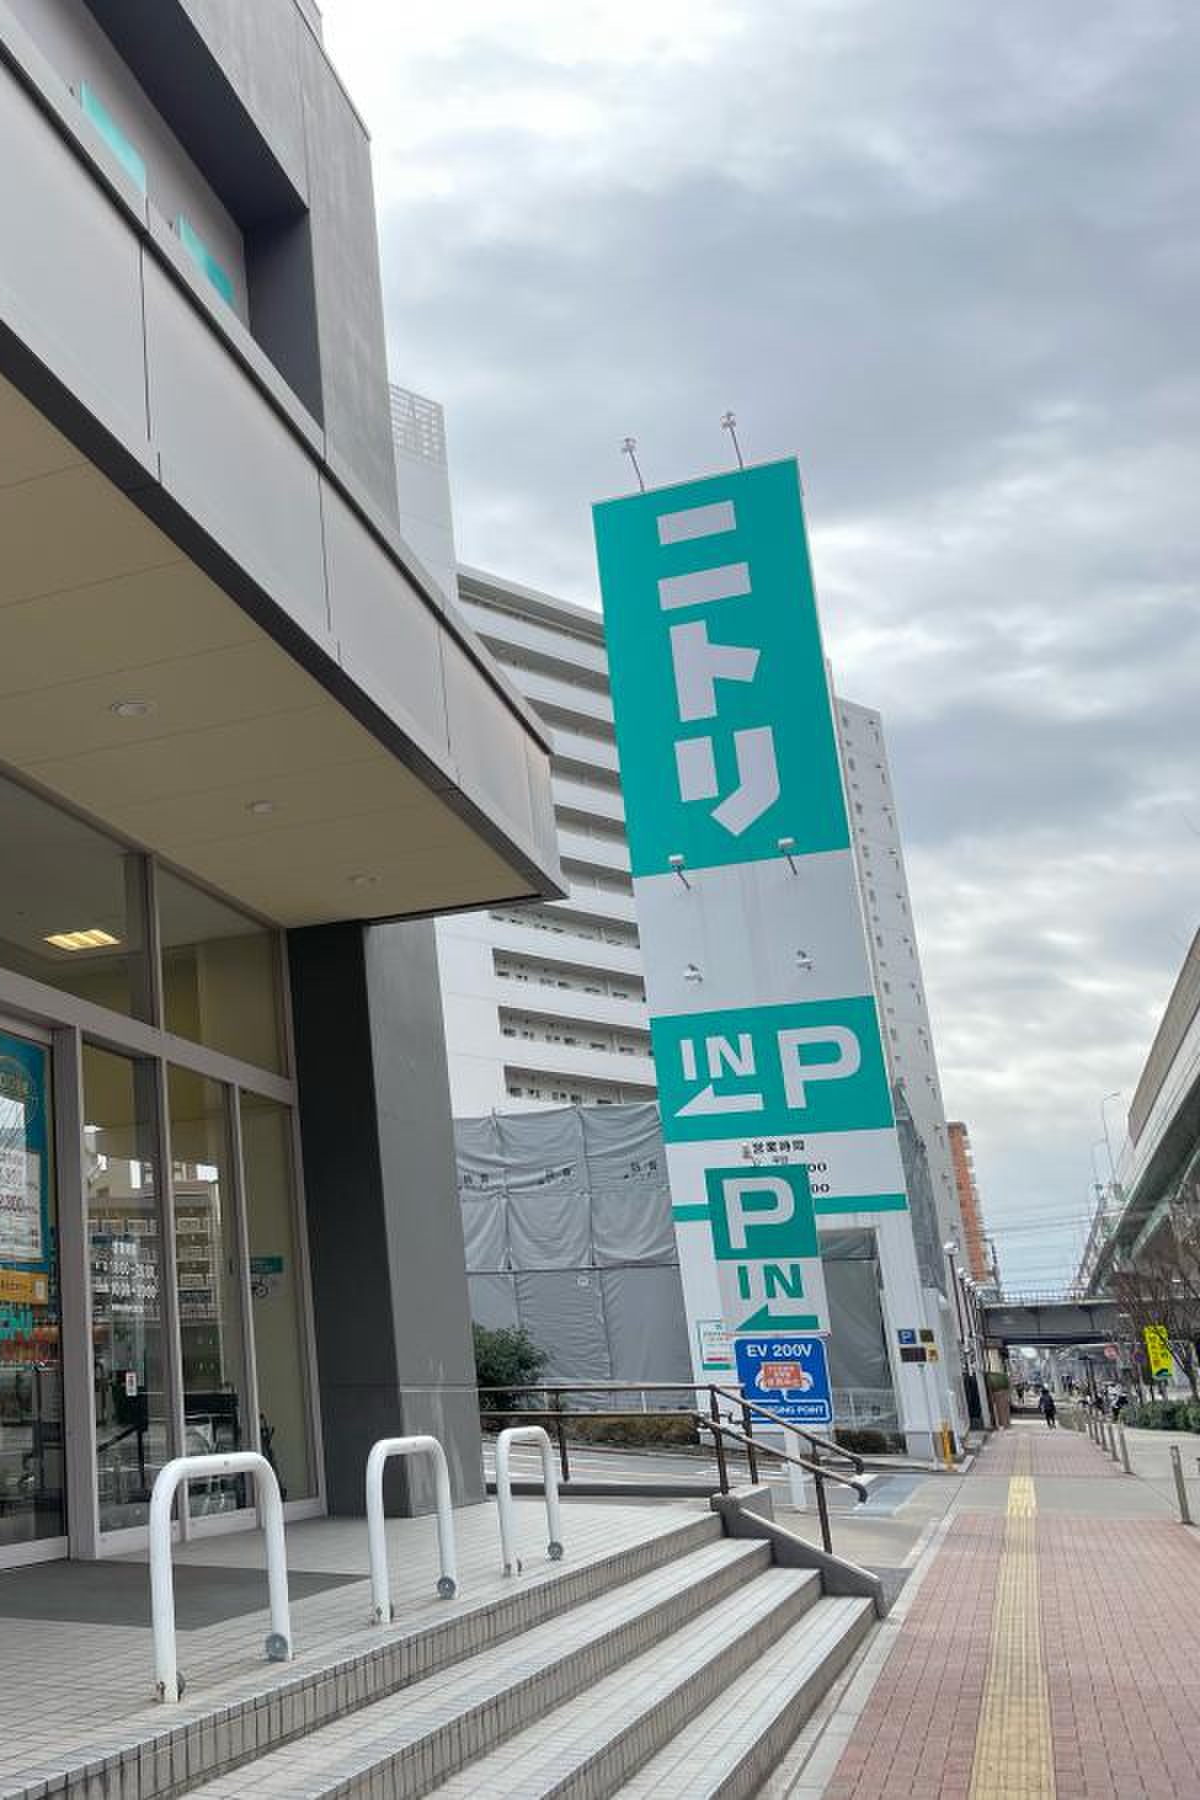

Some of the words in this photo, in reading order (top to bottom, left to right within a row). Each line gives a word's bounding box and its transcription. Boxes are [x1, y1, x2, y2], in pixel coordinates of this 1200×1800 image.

[657, 500, 781, 836] ニトリ
[679, 1033, 757, 1081] IN
[777, 1025, 862, 1109] P
[722, 1176, 796, 1250] P
[736, 1263, 805, 1301] IN
[746, 1344, 769, 1358] EV
[772, 1343, 813, 1358] 200V
